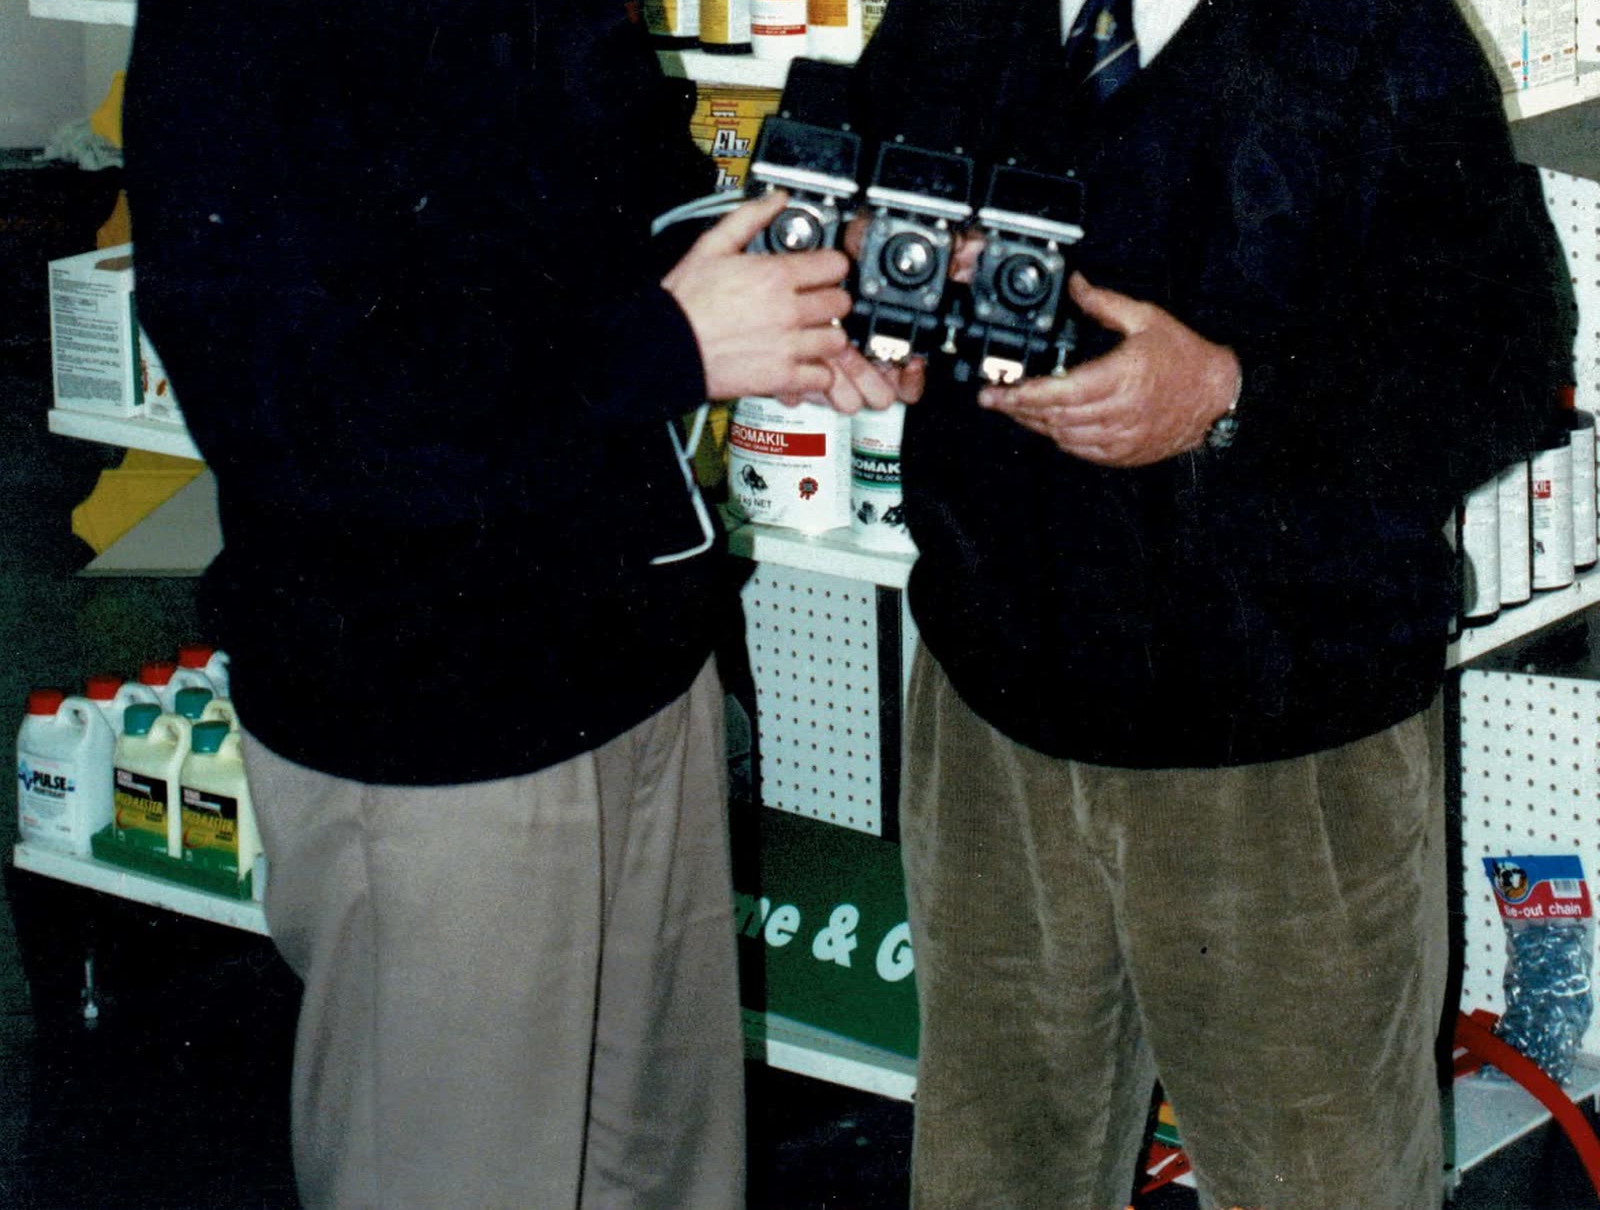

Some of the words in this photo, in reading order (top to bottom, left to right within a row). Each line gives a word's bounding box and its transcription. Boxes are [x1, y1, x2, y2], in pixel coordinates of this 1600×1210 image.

[753, 498, 772, 509] NET
[33, 770, 67, 791] PULSE
[1549, 902, 1582, 915] chain
[812, 903, 860, 968] &
